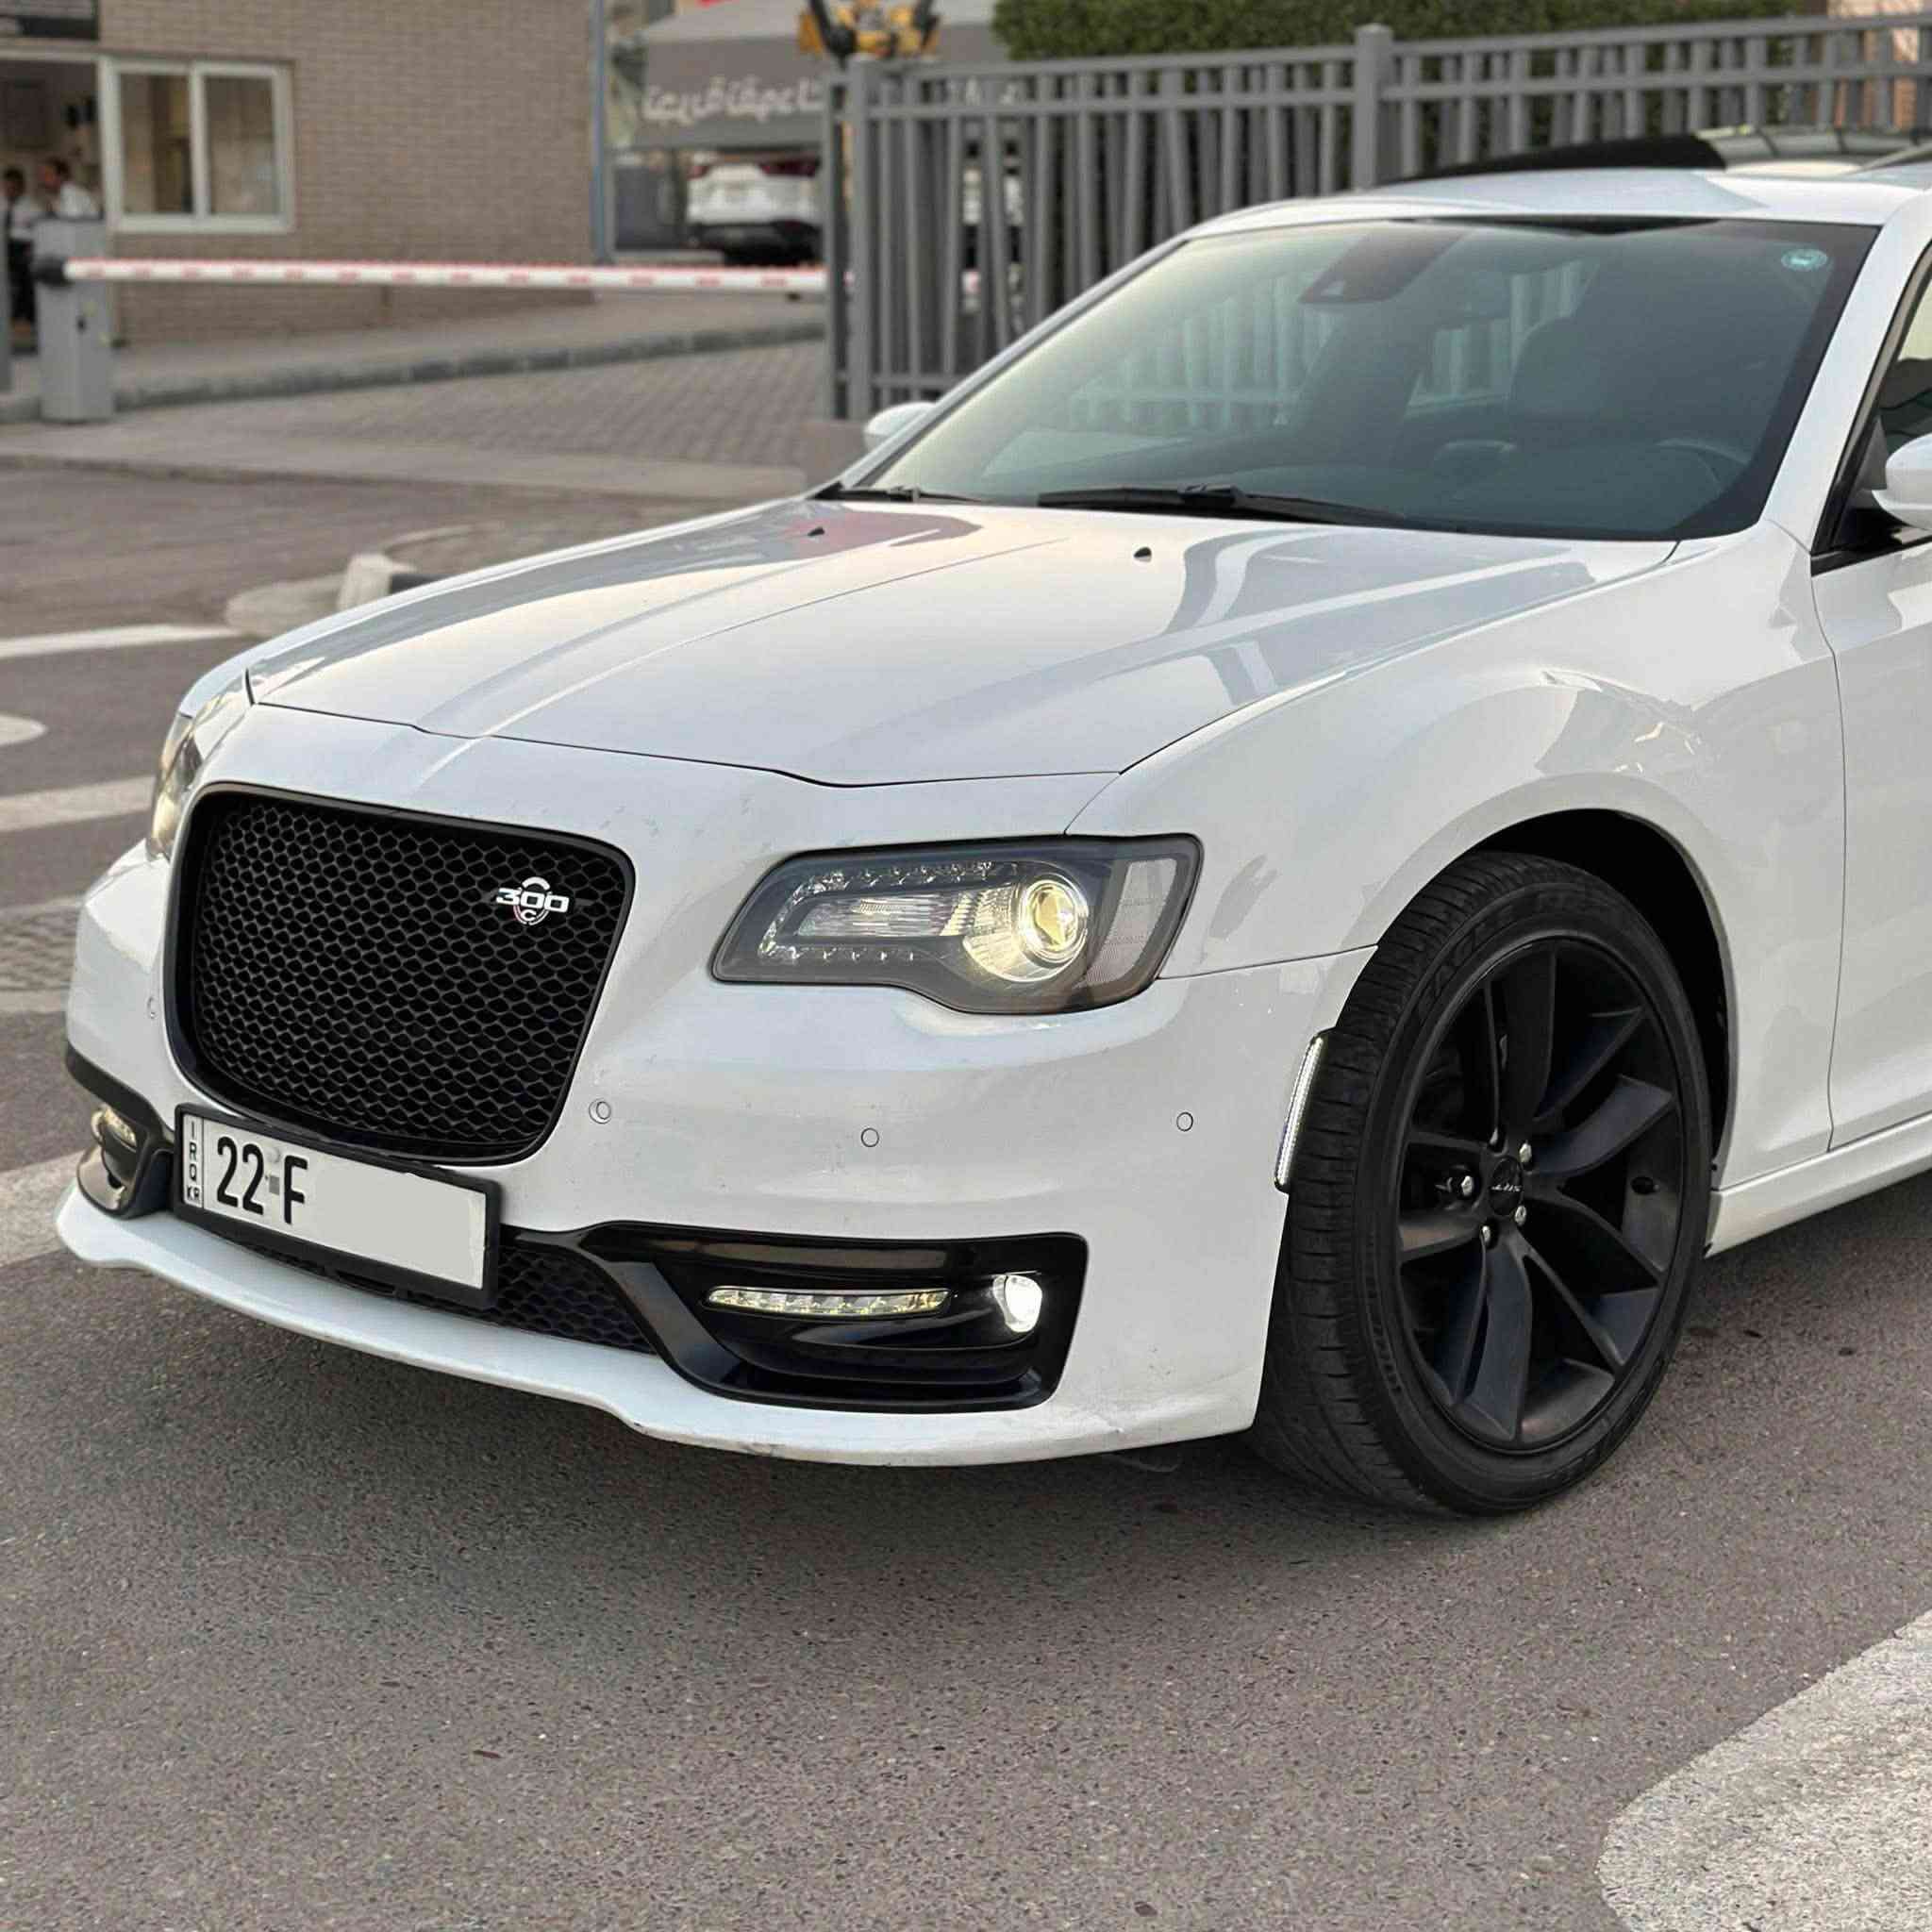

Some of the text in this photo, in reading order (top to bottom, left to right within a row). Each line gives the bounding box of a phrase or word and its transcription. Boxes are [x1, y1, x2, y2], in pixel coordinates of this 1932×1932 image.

[496, 887, 570, 913] 300
[217, 1136, 308, 1225] 22 F
